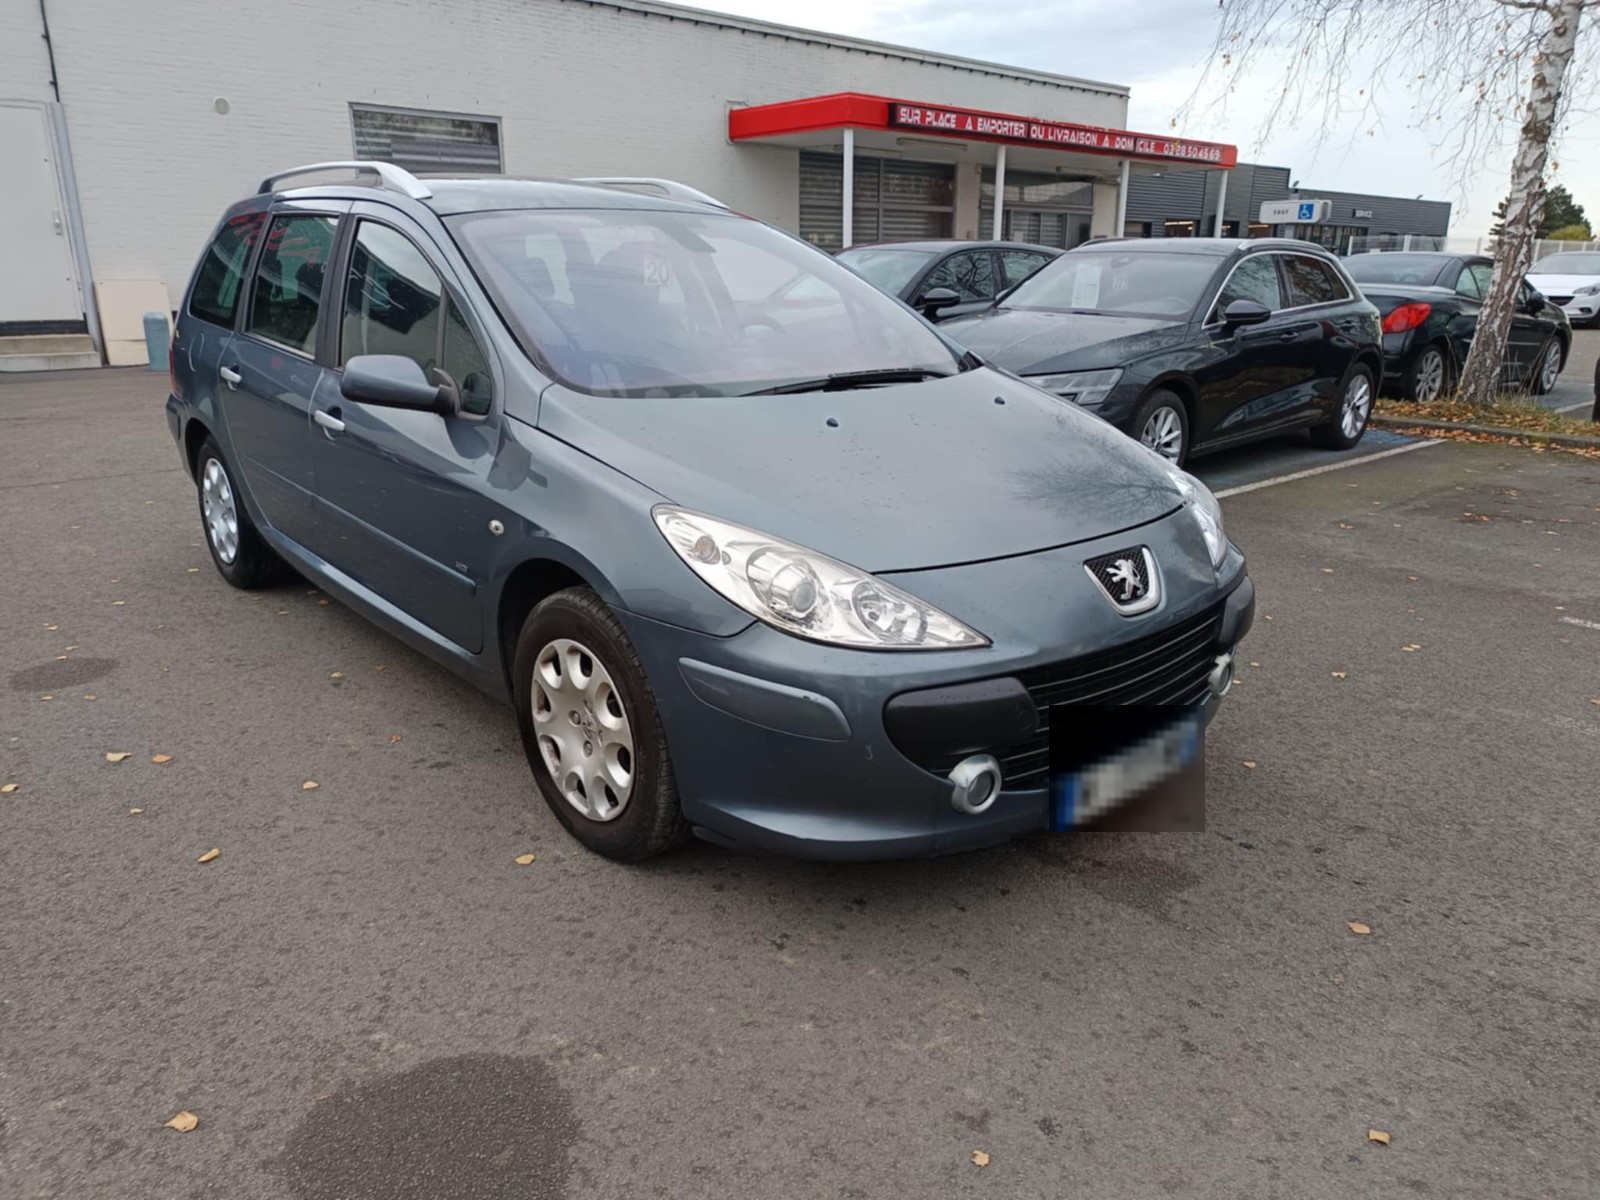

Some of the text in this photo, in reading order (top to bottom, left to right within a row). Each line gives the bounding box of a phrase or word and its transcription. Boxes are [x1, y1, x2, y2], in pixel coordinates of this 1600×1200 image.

[900, 106, 921, 124] SUR
[925, 111, 957, 129] PLACE
[965, 117, 973, 131] A
[977, 119, 1025, 137] EMPORTER
[1030, 125, 1045, 138] OU
[1048, 126, 1098, 145] LIVRAISON
[1103, 134, 1110, 147] A
[646, 261, 670, 284] 20
